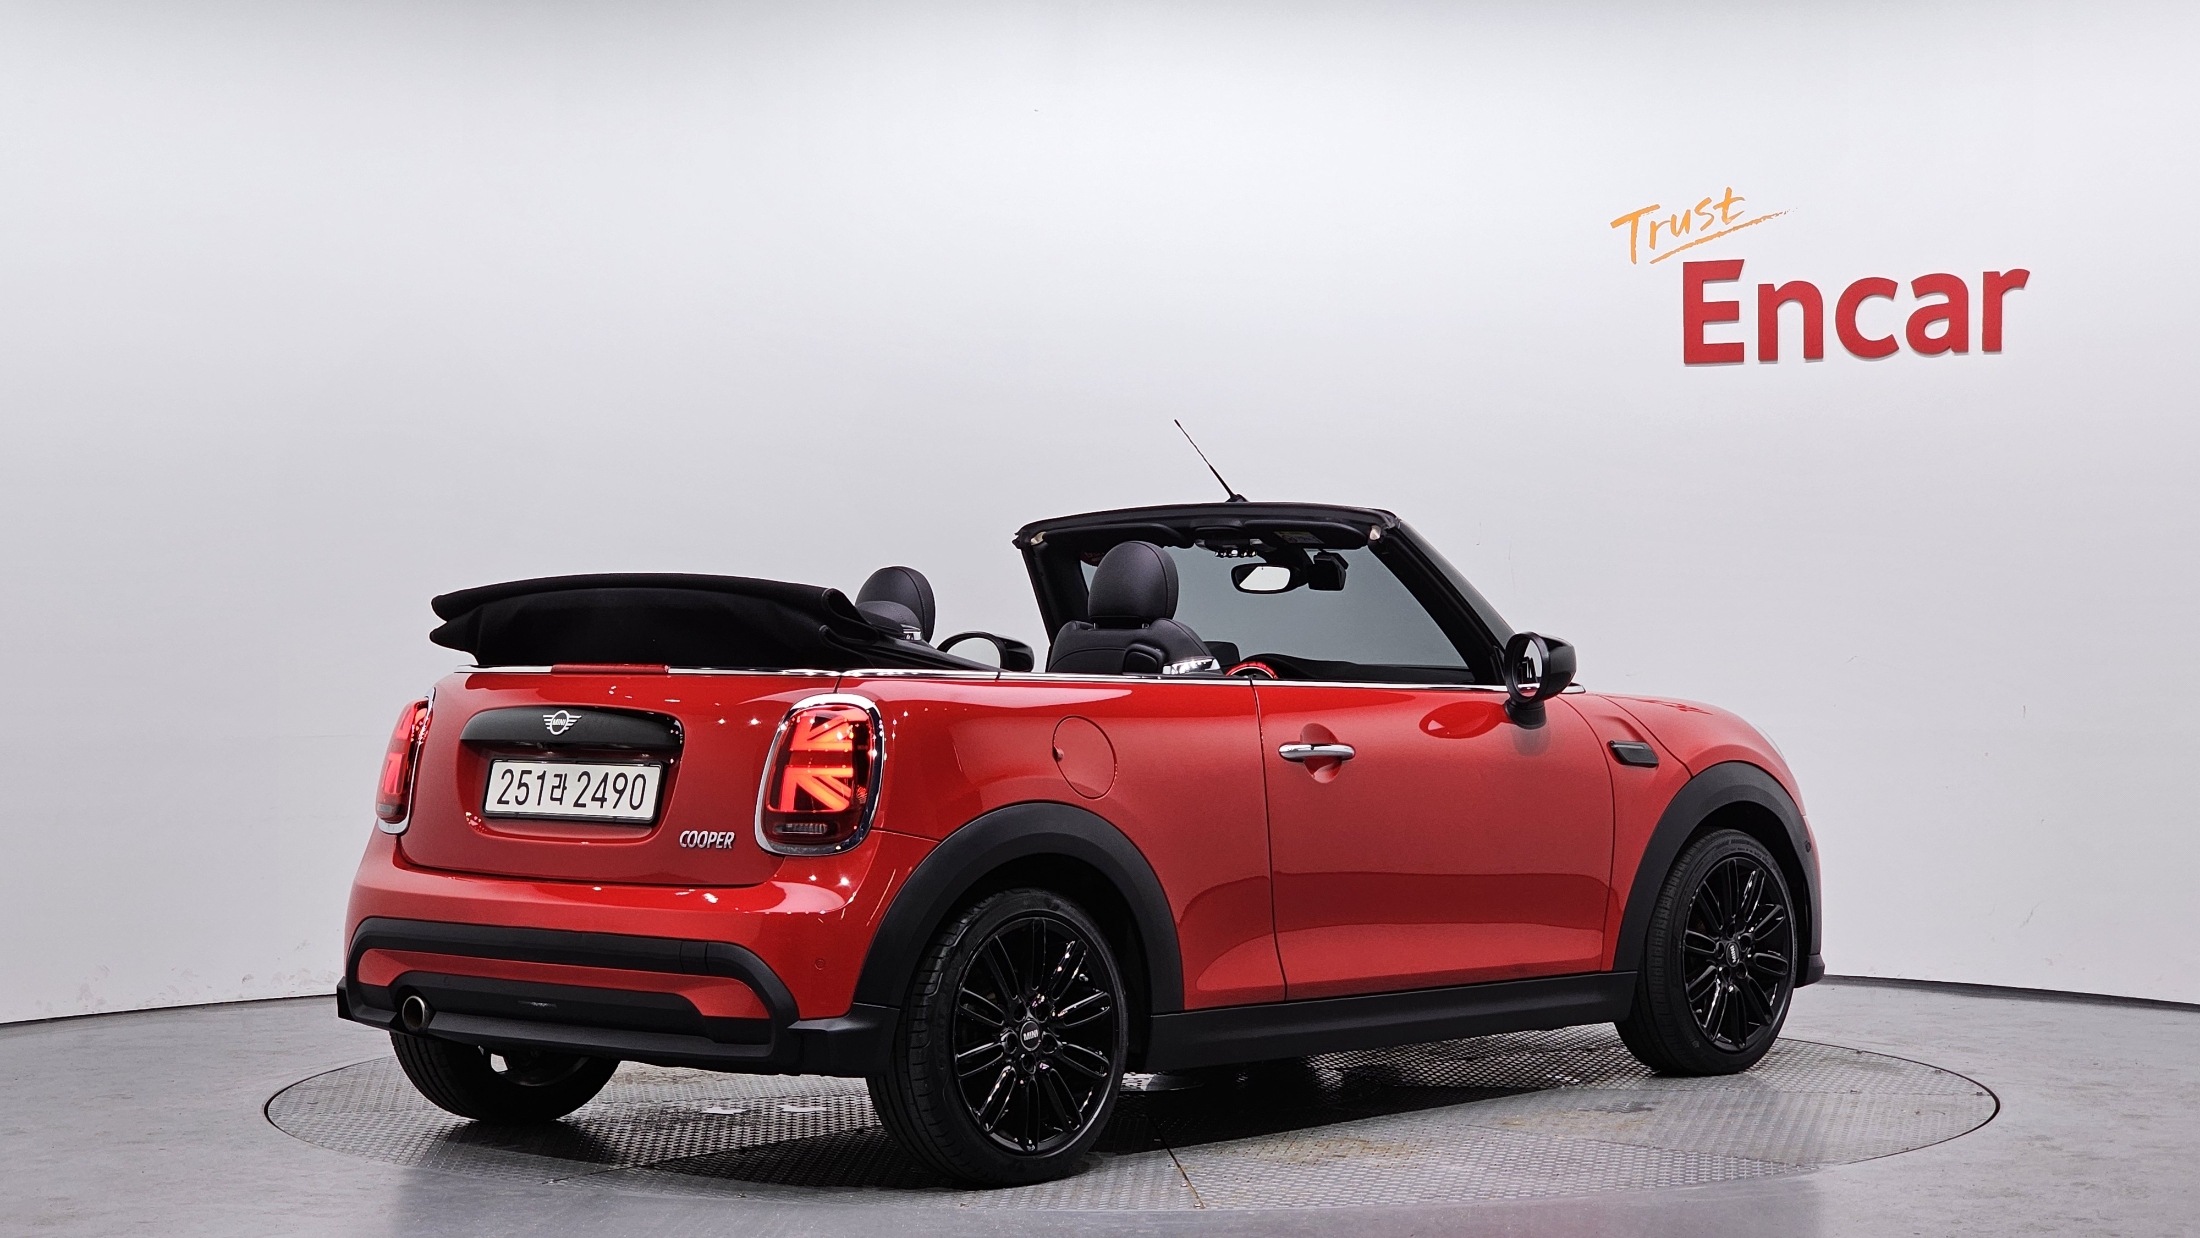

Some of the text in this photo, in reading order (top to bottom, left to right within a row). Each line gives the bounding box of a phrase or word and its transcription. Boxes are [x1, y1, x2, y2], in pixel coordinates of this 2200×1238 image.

[1610, 187, 1745, 264] Trust
[1683, 259, 2030, 364] Encar
[552, 718, 567, 726] MINI
[496, 768, 647, 811] 251라 2490
[679, 830, 735, 849] COOPER
[1023, 1029, 1039, 1041] MINI
